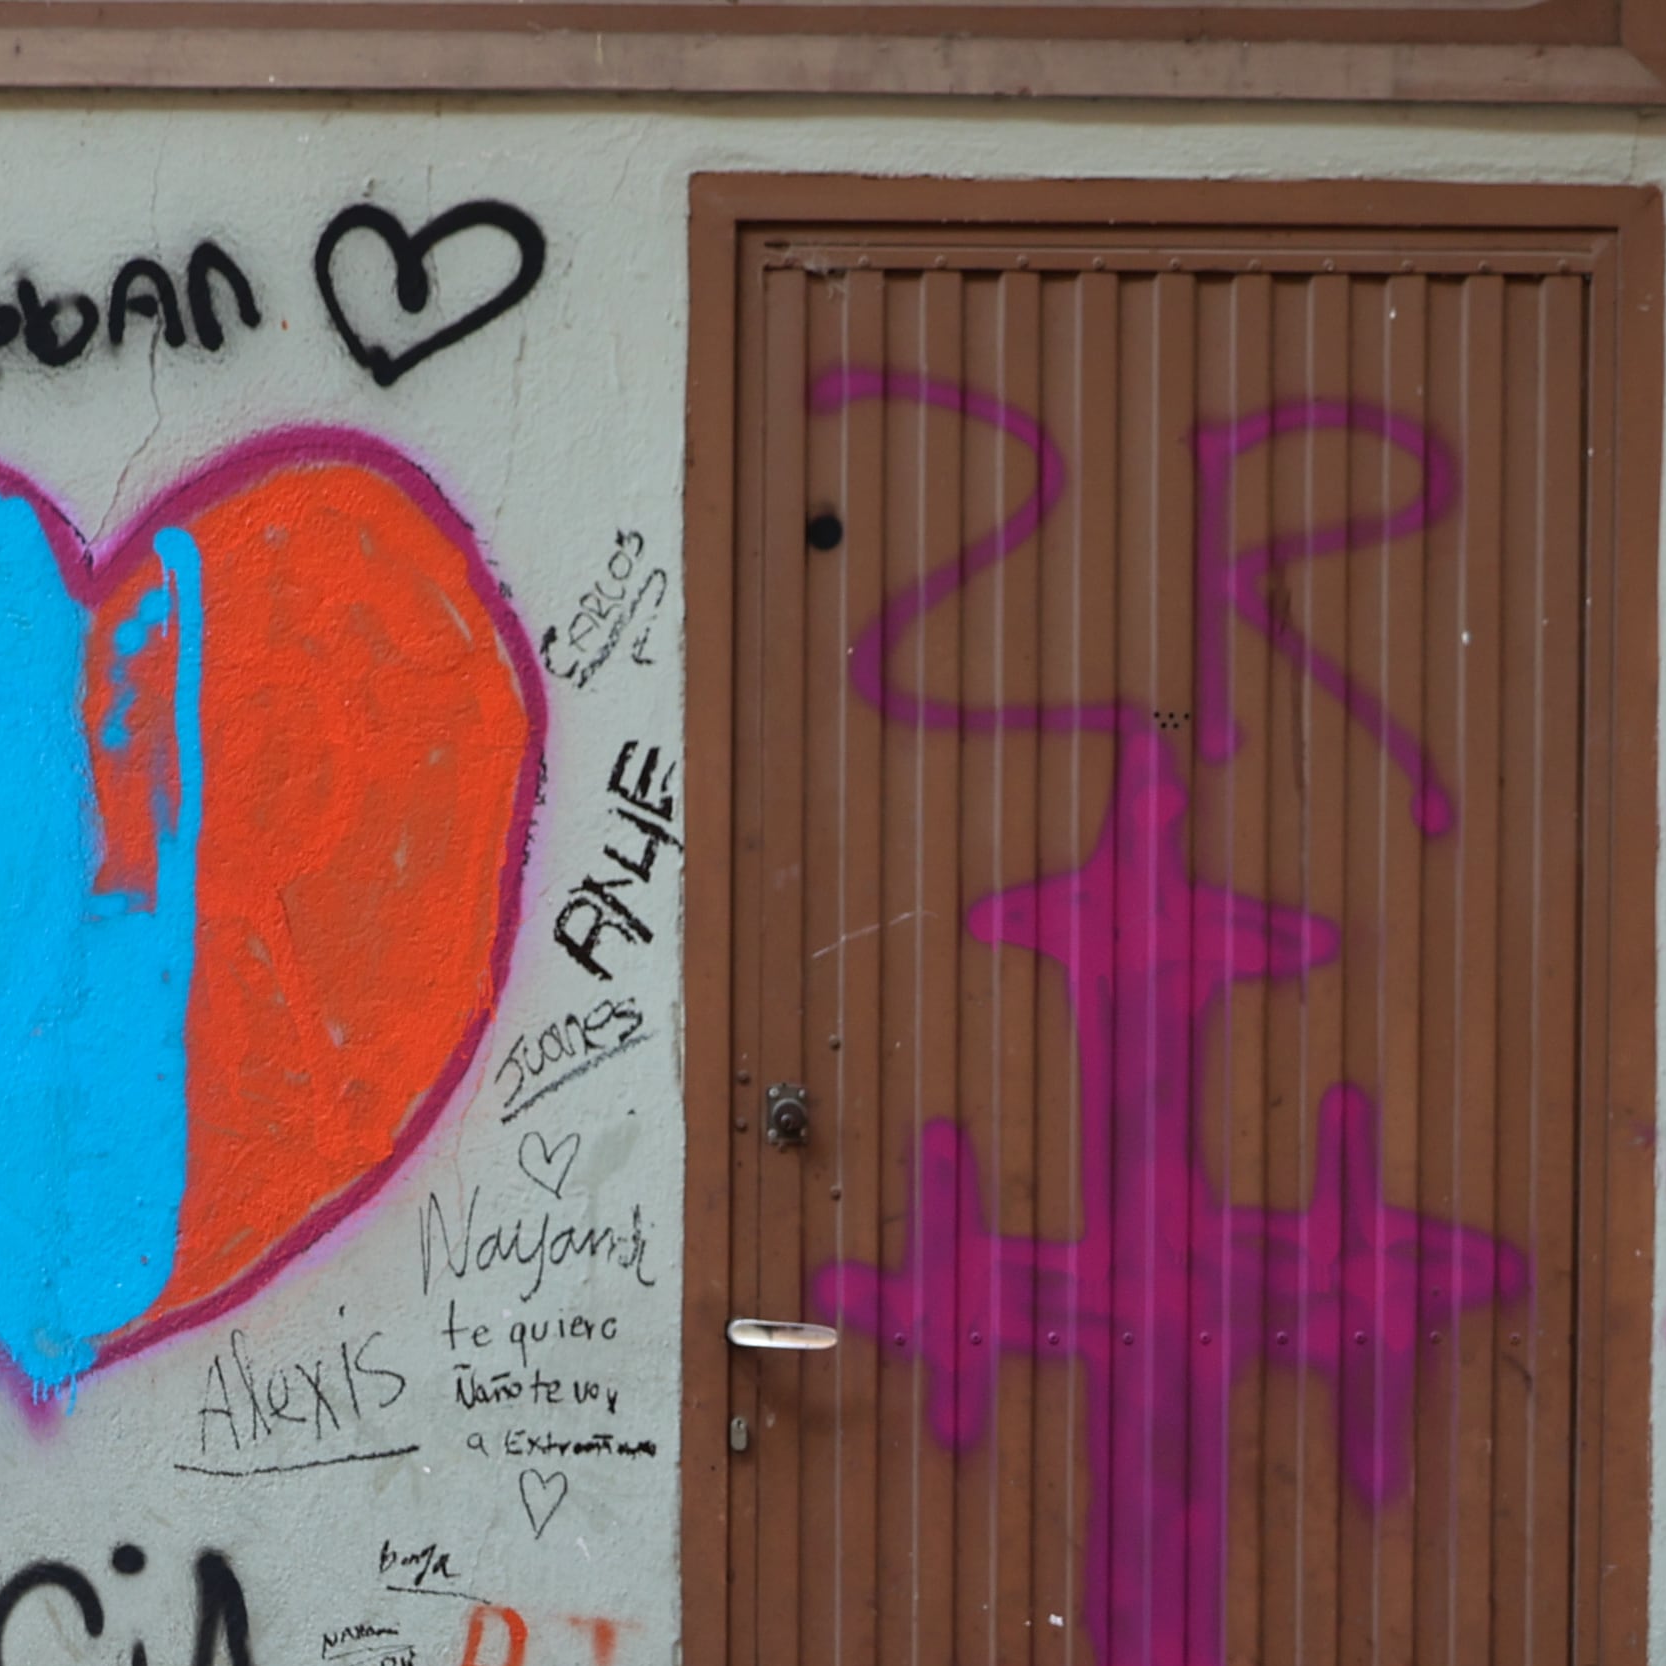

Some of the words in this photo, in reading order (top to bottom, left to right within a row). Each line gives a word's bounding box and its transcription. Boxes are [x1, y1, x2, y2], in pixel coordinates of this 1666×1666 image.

[441, 1299, 493, 1350] te
[509, 1308, 618, 1369] quiero
[572, 1379, 620, 1415] voy
